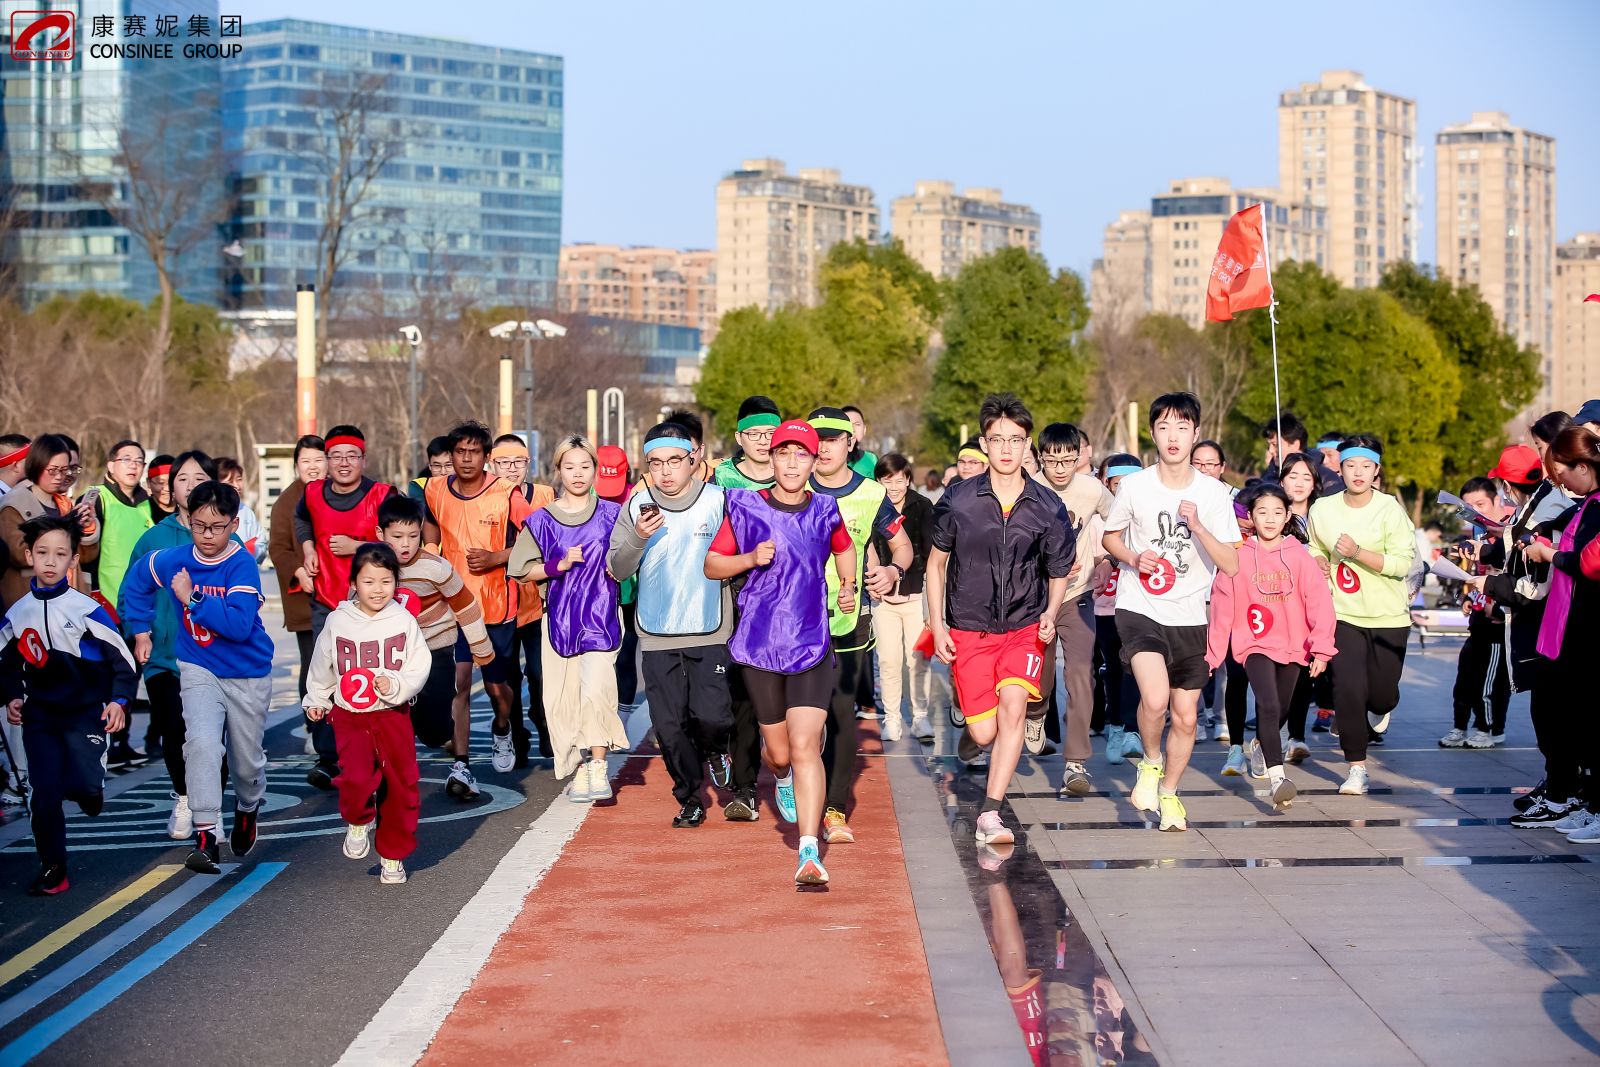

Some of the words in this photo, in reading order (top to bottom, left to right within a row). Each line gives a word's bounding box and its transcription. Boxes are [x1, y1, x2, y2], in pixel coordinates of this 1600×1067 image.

[1148, 563, 1166, 590] 8
[1342, 567, 1355, 589] 9
[1250, 608, 1265, 635] 3
[26, 633, 43, 662] 6
[335, 632, 407, 676] ABC
[1025, 653, 1041, 678] 17
[350, 673, 370, 703] 2
